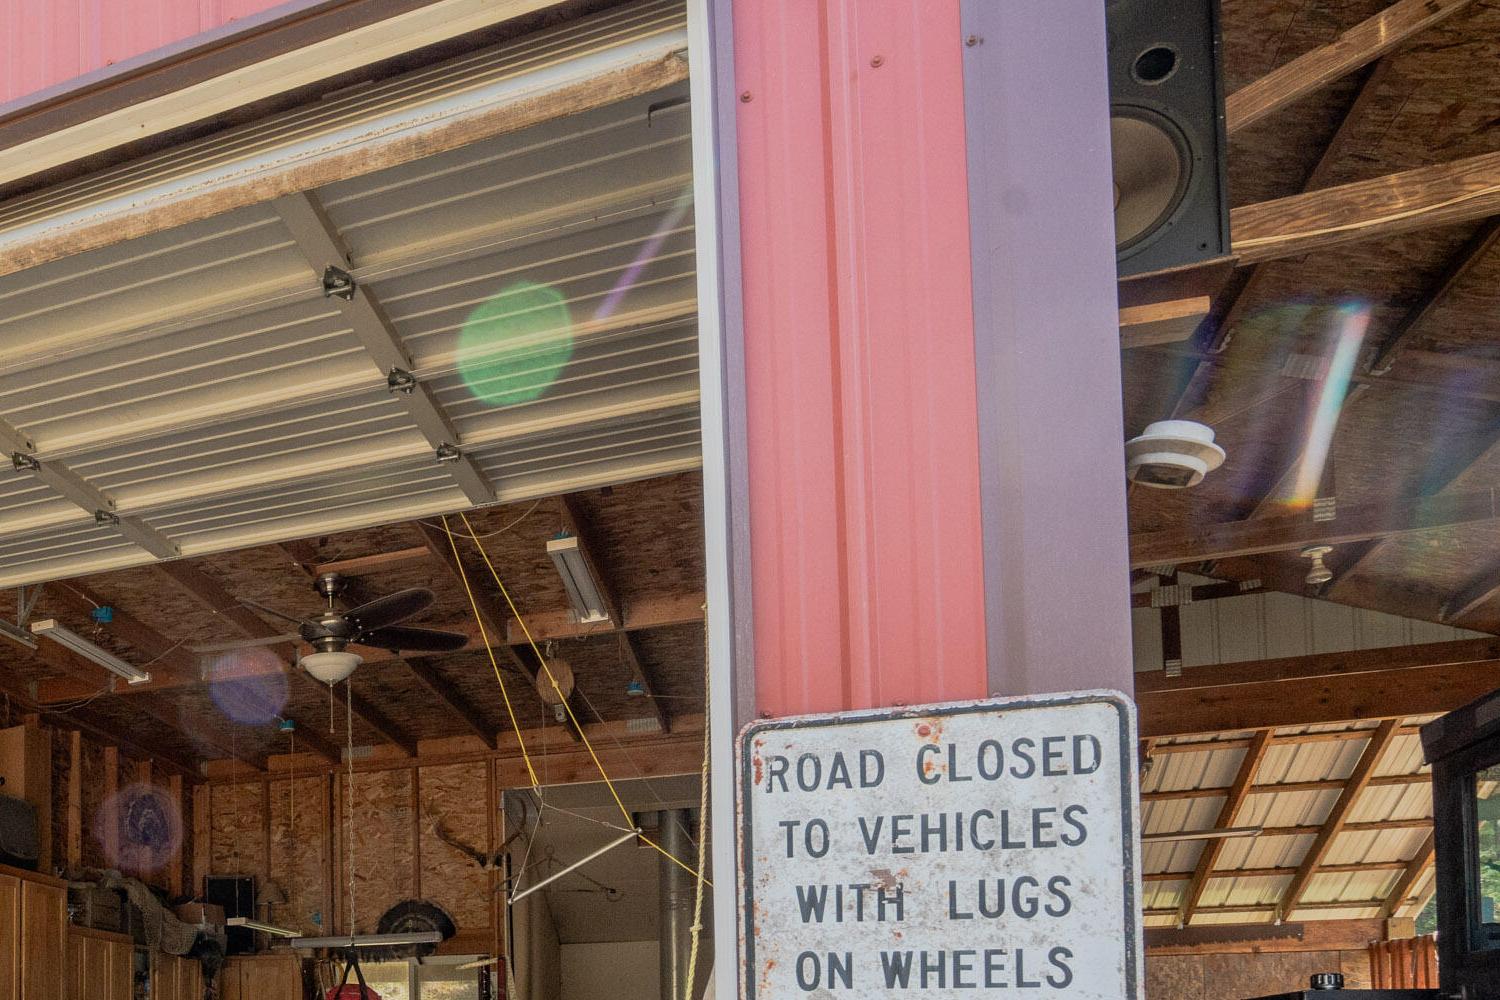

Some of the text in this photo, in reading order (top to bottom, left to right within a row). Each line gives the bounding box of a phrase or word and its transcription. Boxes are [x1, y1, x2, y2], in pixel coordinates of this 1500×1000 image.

[766, 734, 1102, 794] ROAD CLOSED
[779, 804, 1089, 859] TO VEHICLES
[796, 875, 1073, 923] WITH LUGS
[796, 946, 1075, 992] ON WHEELS
